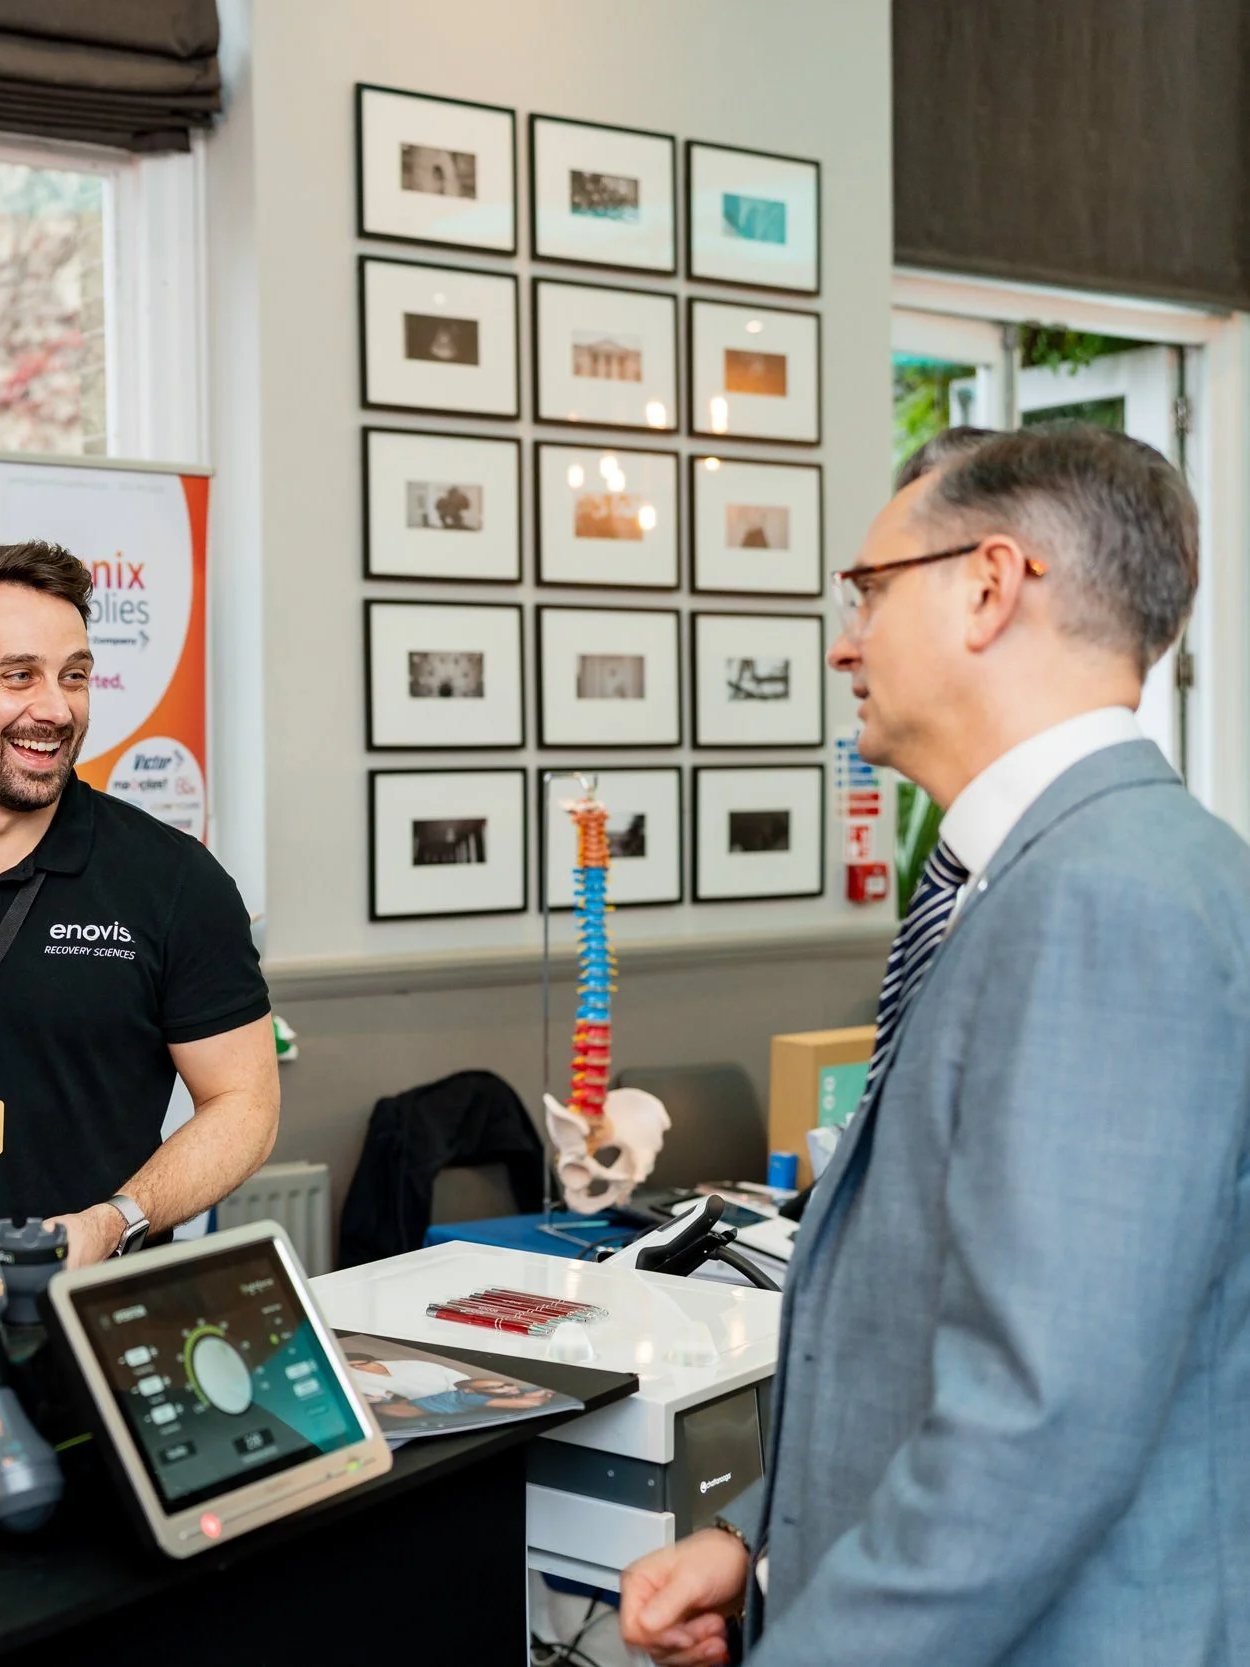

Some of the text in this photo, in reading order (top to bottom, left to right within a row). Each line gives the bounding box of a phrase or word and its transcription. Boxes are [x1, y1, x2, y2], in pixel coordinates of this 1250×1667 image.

[86, 550, 146, 590] nix
[44, 945, 136, 961] RECOVERY SCIENCES
